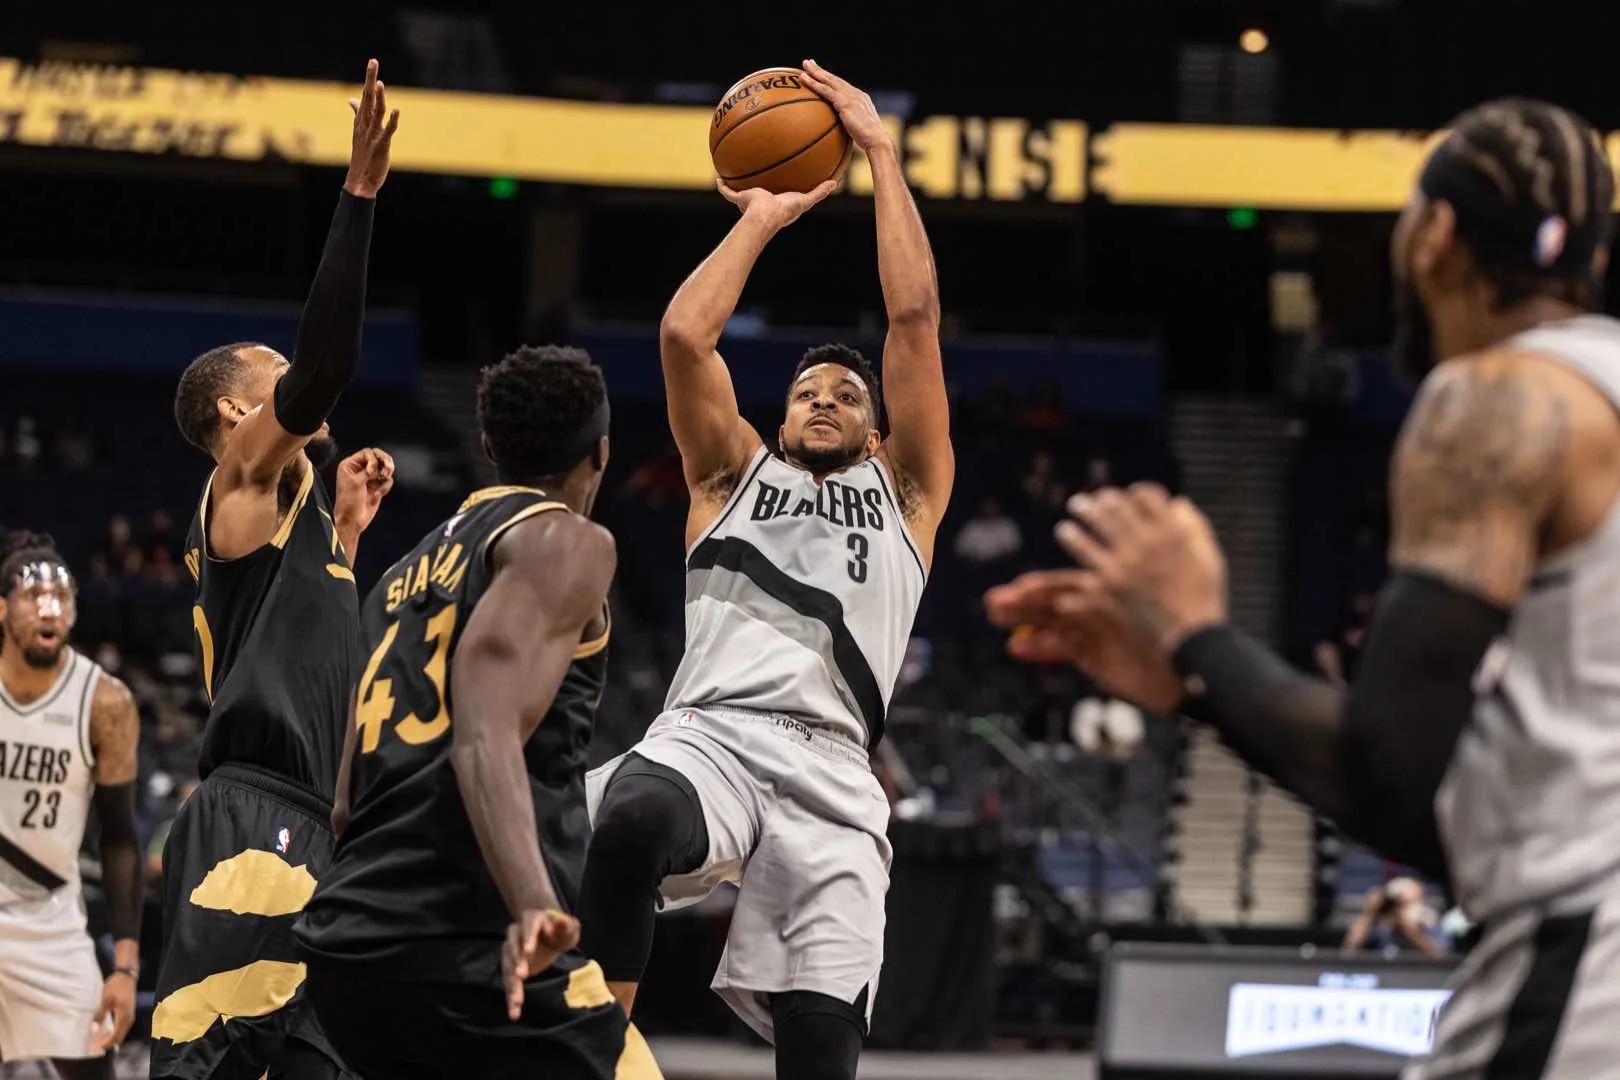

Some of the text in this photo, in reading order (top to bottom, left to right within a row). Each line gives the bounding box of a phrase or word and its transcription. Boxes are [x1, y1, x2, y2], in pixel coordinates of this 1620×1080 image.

[714, 75, 802, 128] SPALDING
[847, 532, 869, 584] 3
[355, 603, 458, 754] 43
[20, 789, 62, 829] 23
[1240, 997, 1437, 1038] FOUNDATIO
